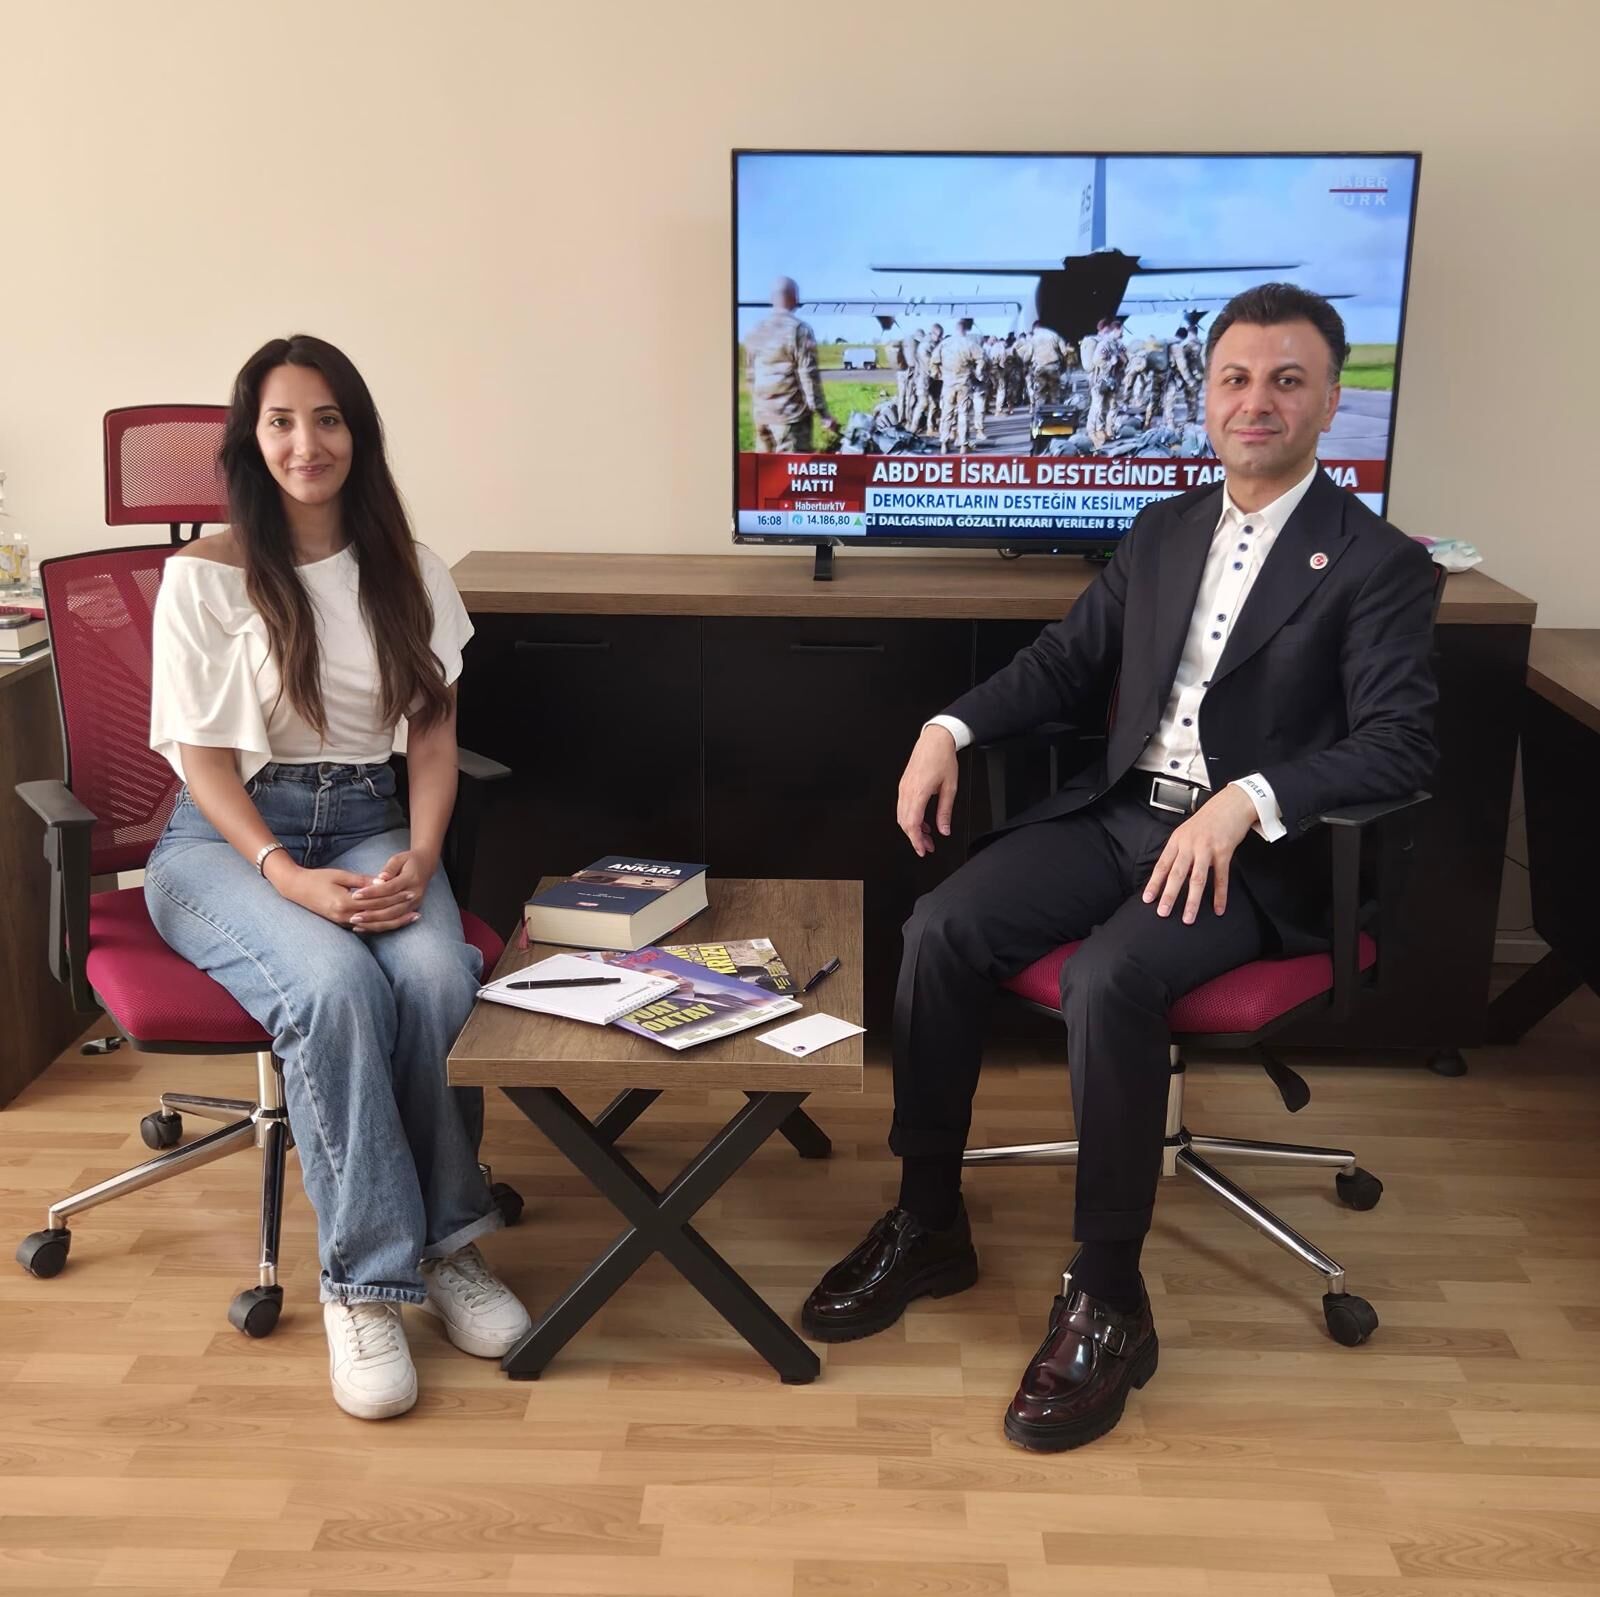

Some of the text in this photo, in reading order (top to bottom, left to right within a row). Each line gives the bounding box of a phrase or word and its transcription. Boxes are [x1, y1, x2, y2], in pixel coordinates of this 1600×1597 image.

[1329, 176, 1388, 188] ABER
[787, 462, 837, 476] HABER
[872, 458, 1358, 488] ABD'DE İSRAİL DESTEĞİNDE TAR MA
[791, 479, 834, 492] HATTI
[872, 492, 1174, 511] DEMOKRATLARIN DESTEĞİN KESİLME
[757, 515, 782, 526] 16:08
[807, 515, 850, 527] 14.186,80
[879, 515, 953, 527] DALGASINDA
[956, 514, 1006, 528] GÖZALTI
[1009, 516, 1053, 528] KARARI
[1055, 516, 1104, 529] VERİLEN
[1107, 518, 1115, 529] 8
[1117, 517, 1133, 531] ŞÜ
[607, 863, 682, 876] ANKARA
[641, 1003, 716, 1032] OKTAY
